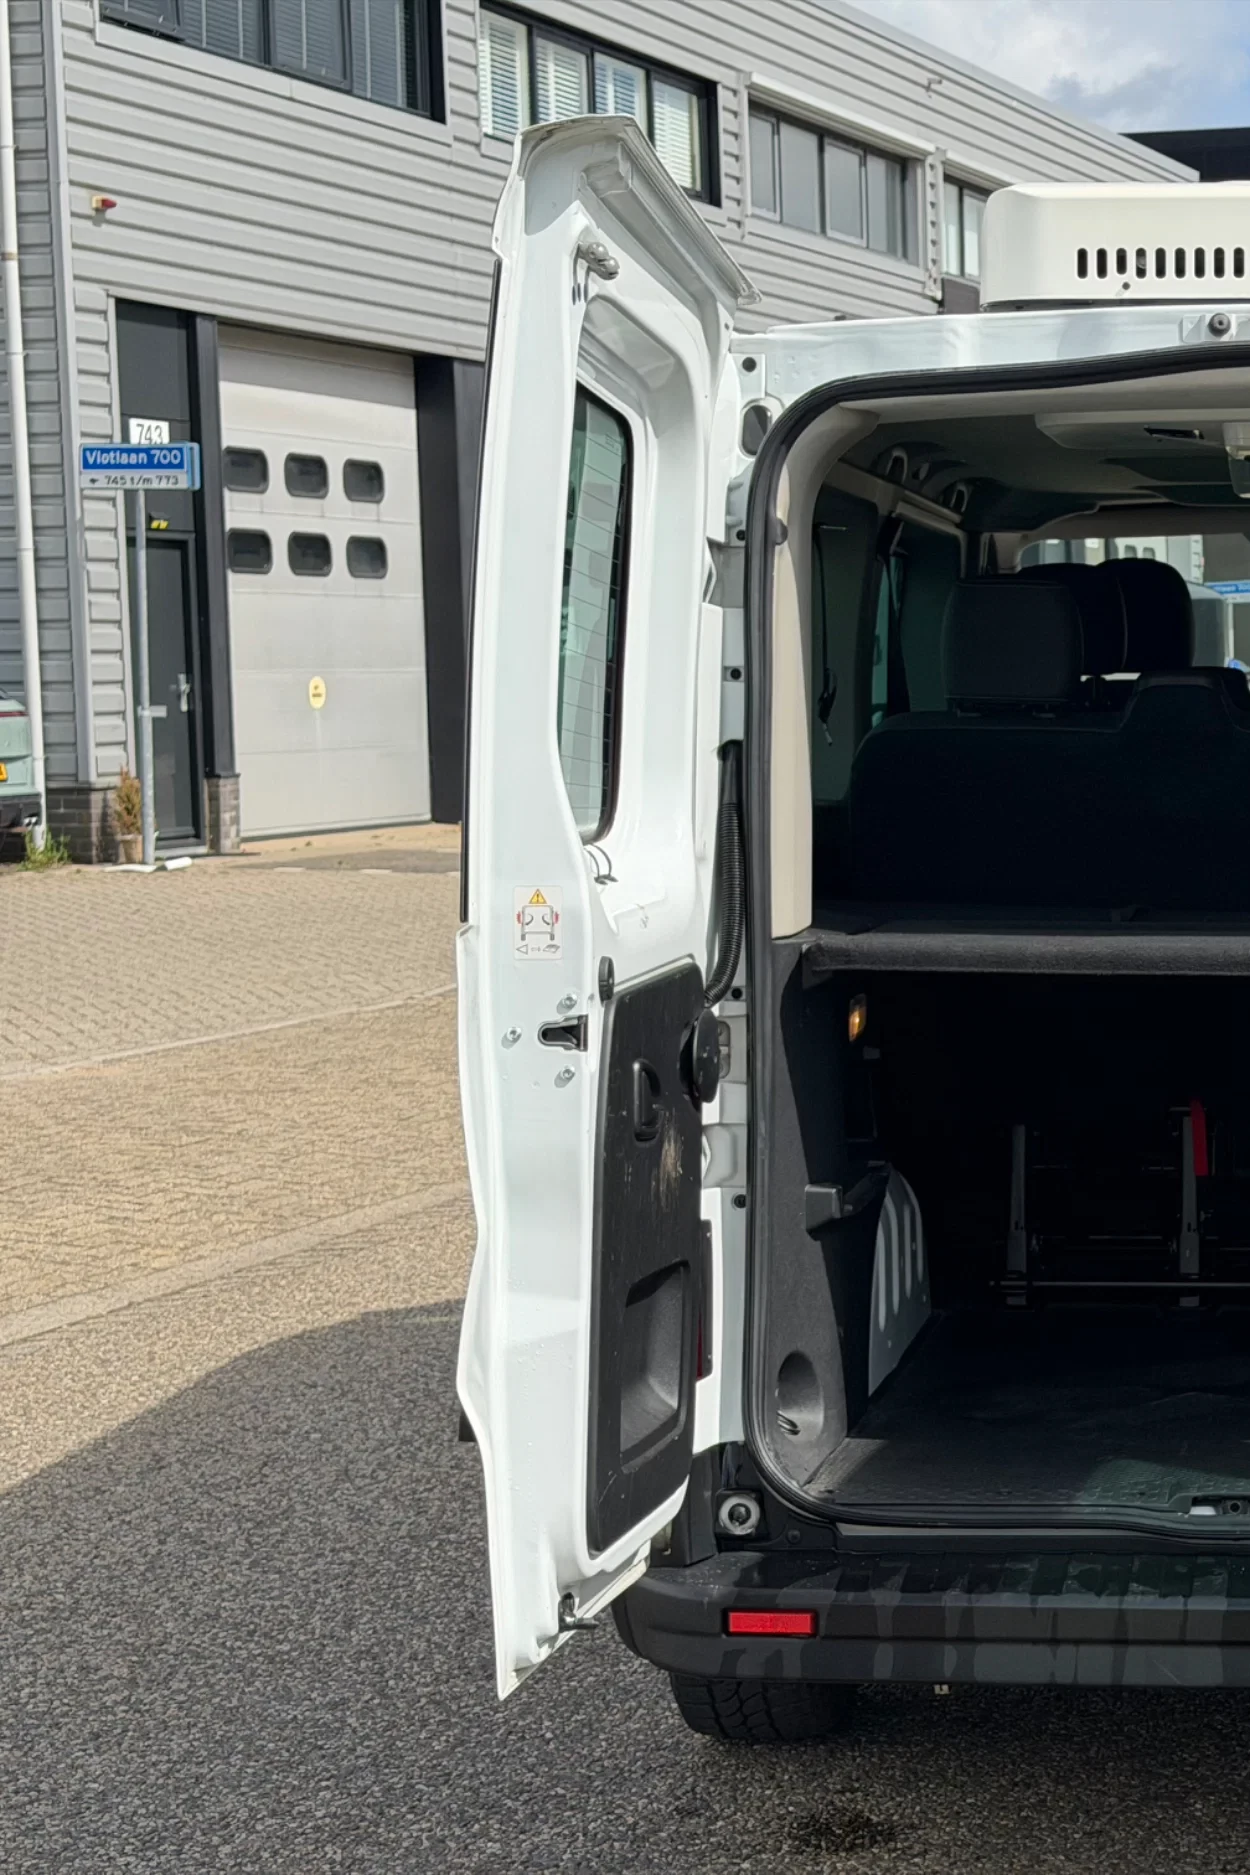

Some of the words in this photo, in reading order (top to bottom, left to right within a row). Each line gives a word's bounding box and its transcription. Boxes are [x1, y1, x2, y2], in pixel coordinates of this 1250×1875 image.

[136, 423, 163, 445] 743
[85, 449, 148, 465] Vlotlaan
[150, 449, 182, 465] 700
[104, 475, 127, 486] 745
[130, 475, 153, 486] t/m
